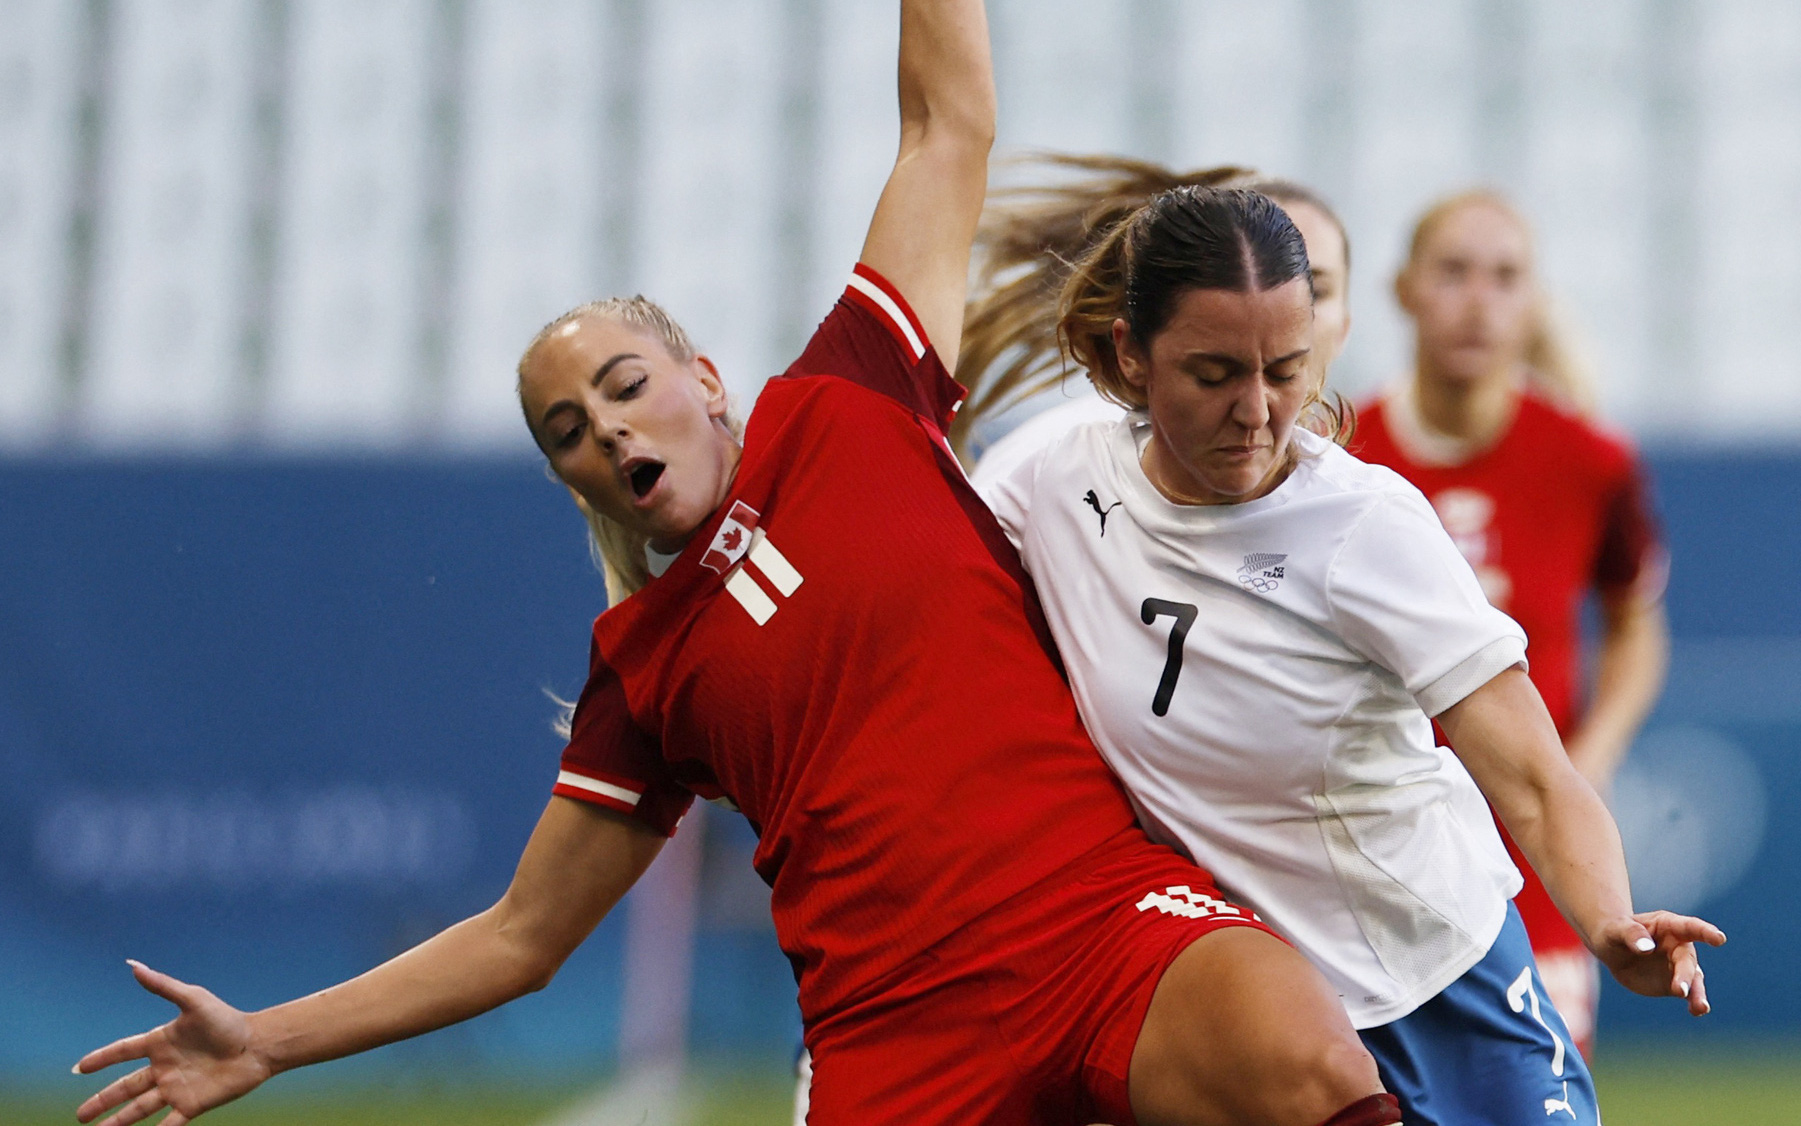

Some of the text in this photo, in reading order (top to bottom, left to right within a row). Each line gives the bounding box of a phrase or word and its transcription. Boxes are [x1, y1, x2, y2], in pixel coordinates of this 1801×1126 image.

[723, 526, 804, 627] 11
[1263, 571, 1284, 579] TEAM
[1141, 597, 1198, 717] 7
[1507, 965, 1565, 1077] 7
